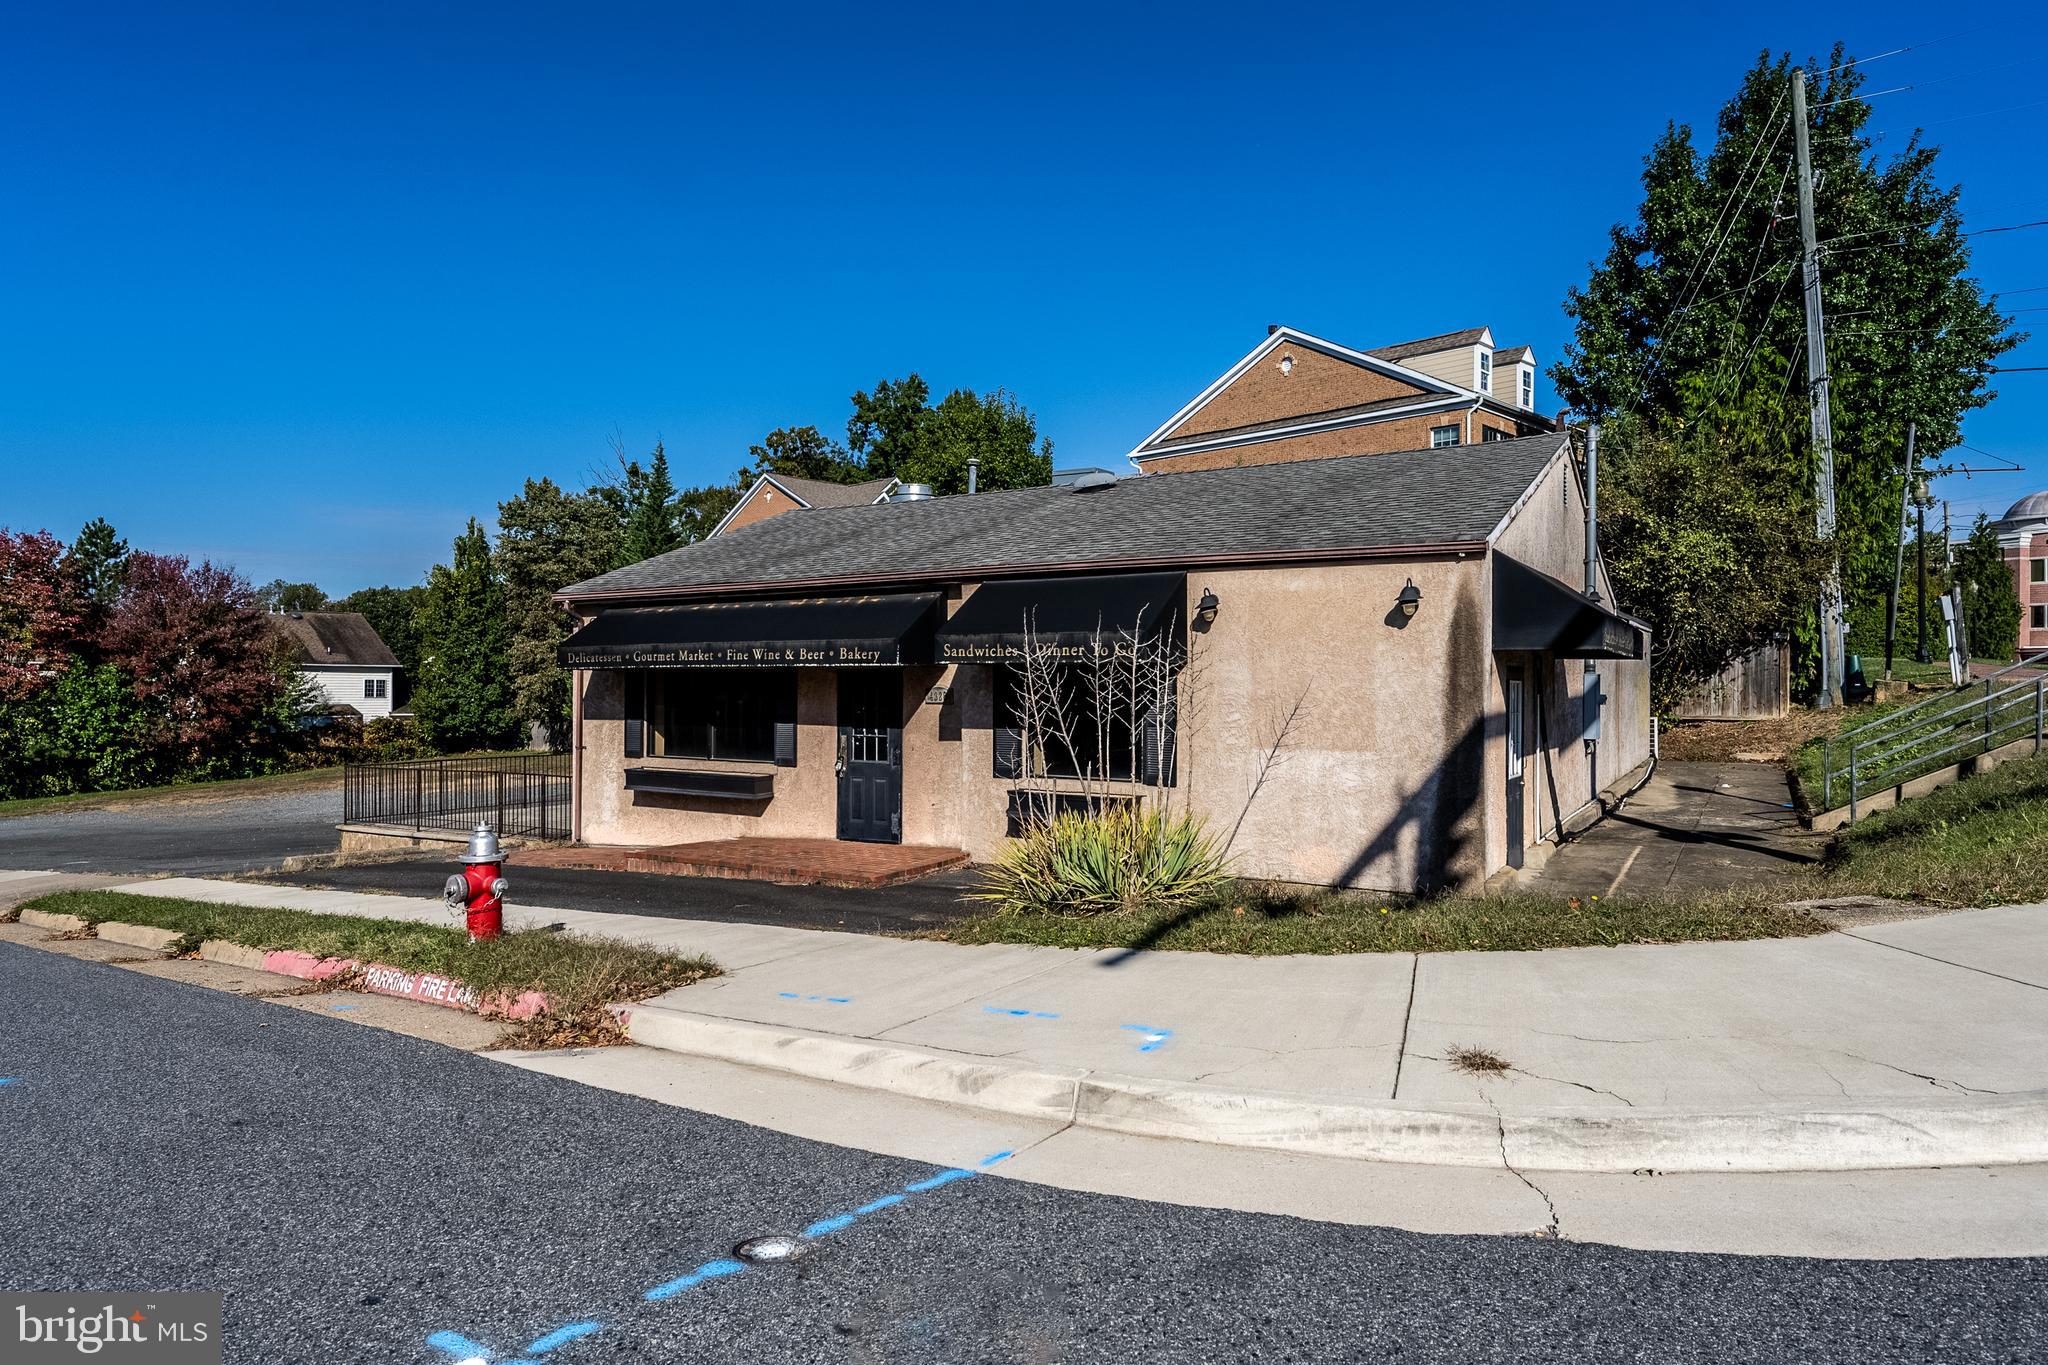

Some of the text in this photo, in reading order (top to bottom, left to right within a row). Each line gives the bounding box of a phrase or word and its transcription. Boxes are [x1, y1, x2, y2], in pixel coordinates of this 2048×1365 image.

[567, 646, 881, 664] Delicatessen Gourmet Market Fine Wine & Beer Bakery
[943, 643, 1018, 657] Sandwiches
[365, 966, 416, 994] PARKING
[418, 975, 449, 1000] FIRE
